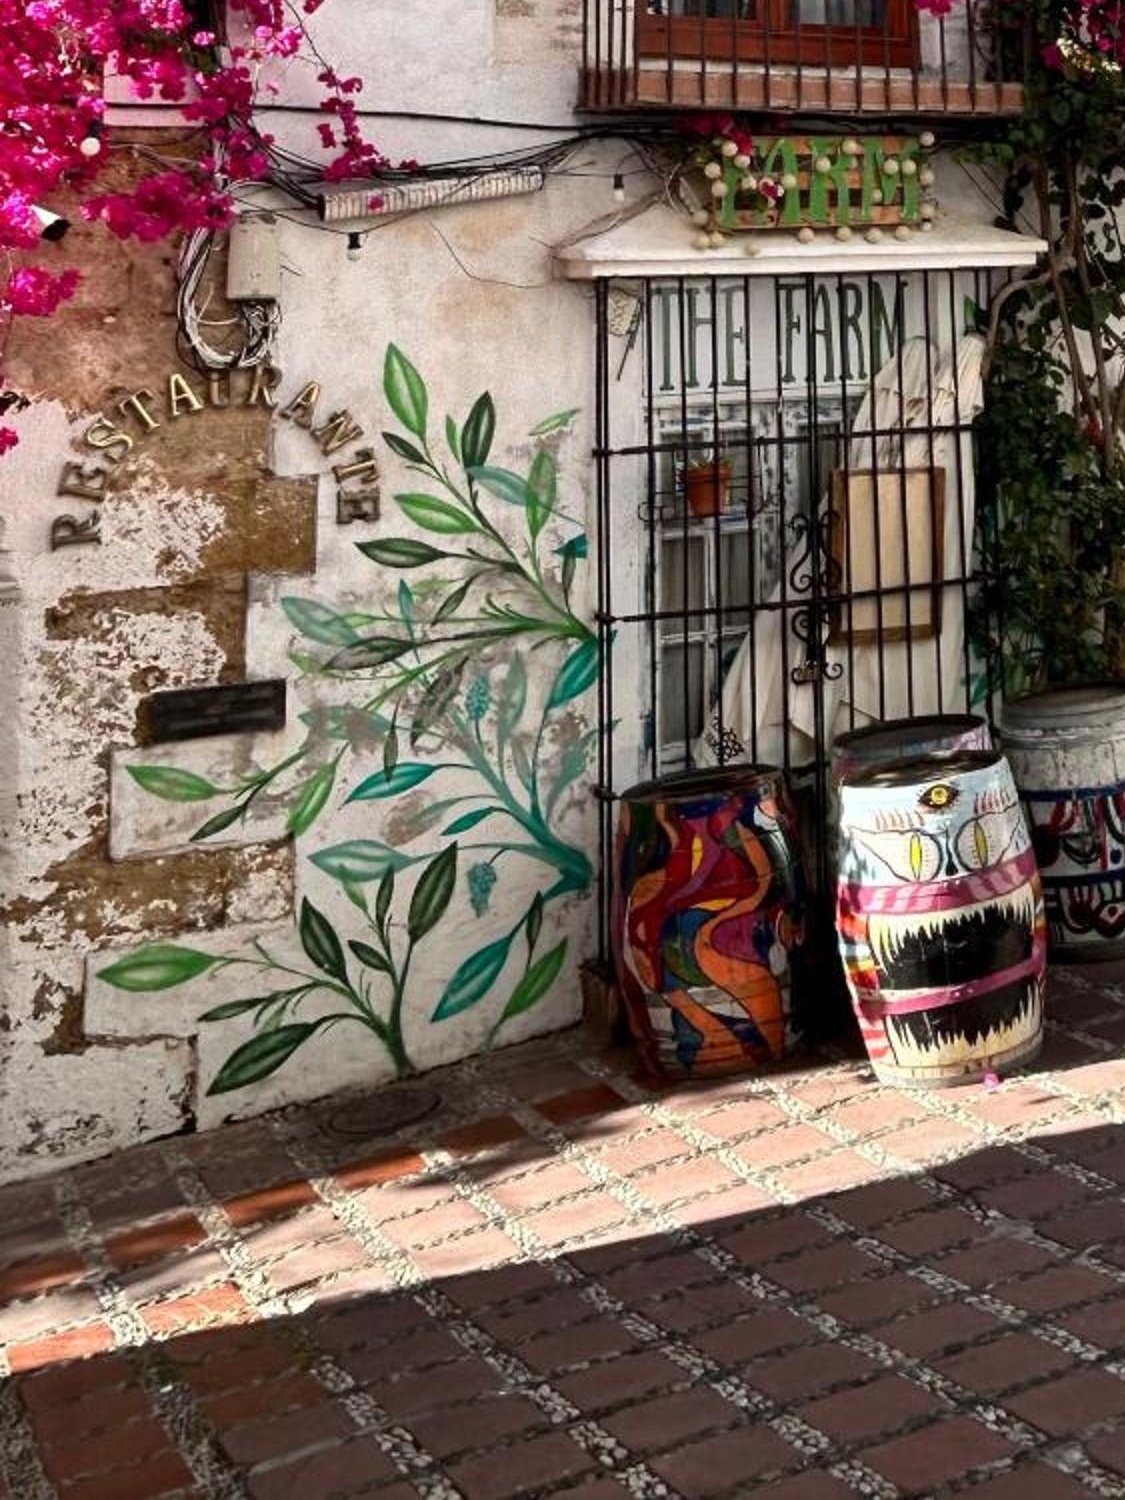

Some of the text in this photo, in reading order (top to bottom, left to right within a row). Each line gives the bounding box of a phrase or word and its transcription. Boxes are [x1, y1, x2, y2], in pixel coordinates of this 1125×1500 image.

[650, 280, 908, 391] THE FARM
[51, 363, 381, 551] RESTAURANTE
